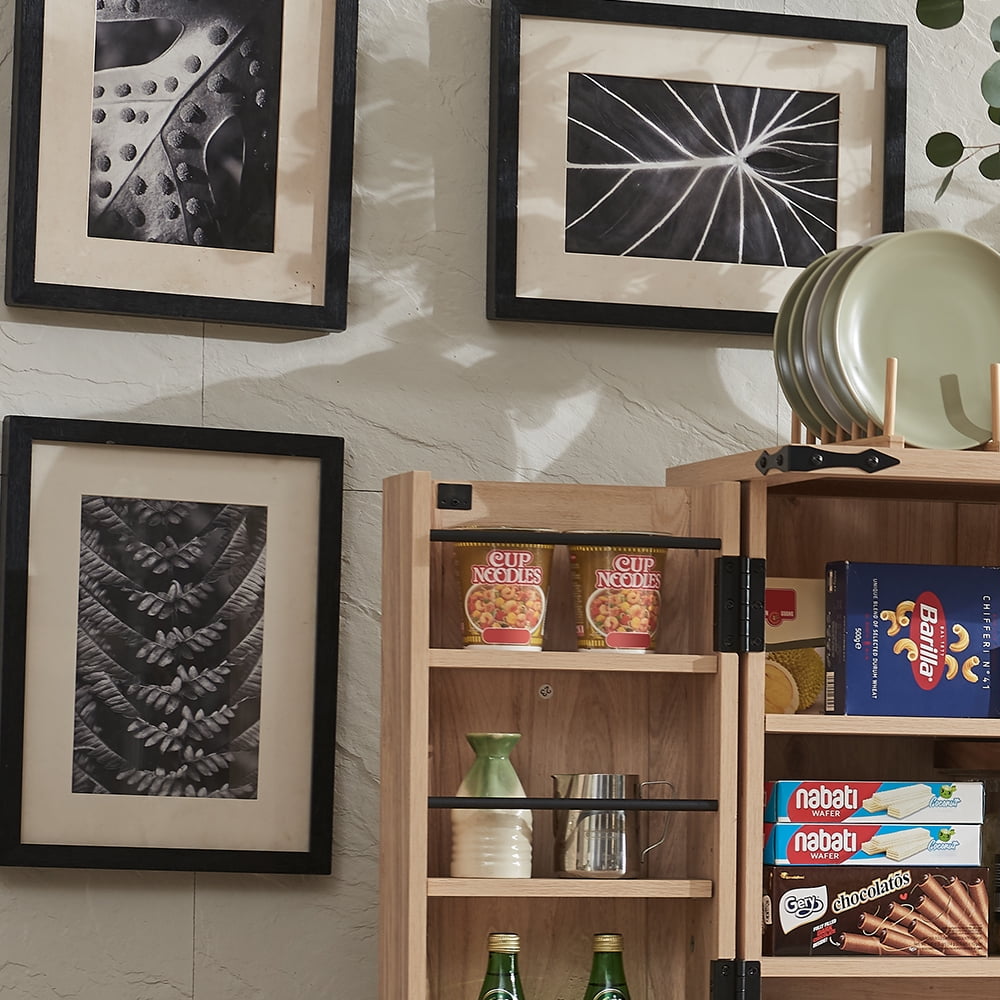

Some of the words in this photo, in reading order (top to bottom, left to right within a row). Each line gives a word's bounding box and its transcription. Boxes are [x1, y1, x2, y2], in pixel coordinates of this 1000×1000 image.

[487, 550, 532, 568] CUP
[613, 555, 656, 573] CUP
[472, 566, 543, 585] NOODLES
[595, 571, 662, 589] NOODLES
[982, 595, 991, 653] CHIFFERI
[871, 629, 879, 657] SELECTED
[919, 603, 938, 677] Barilla
[795, 785, 858, 809] nabati
[794, 828, 857, 852] nabati
[810, 852, 839, 860] WAFER
